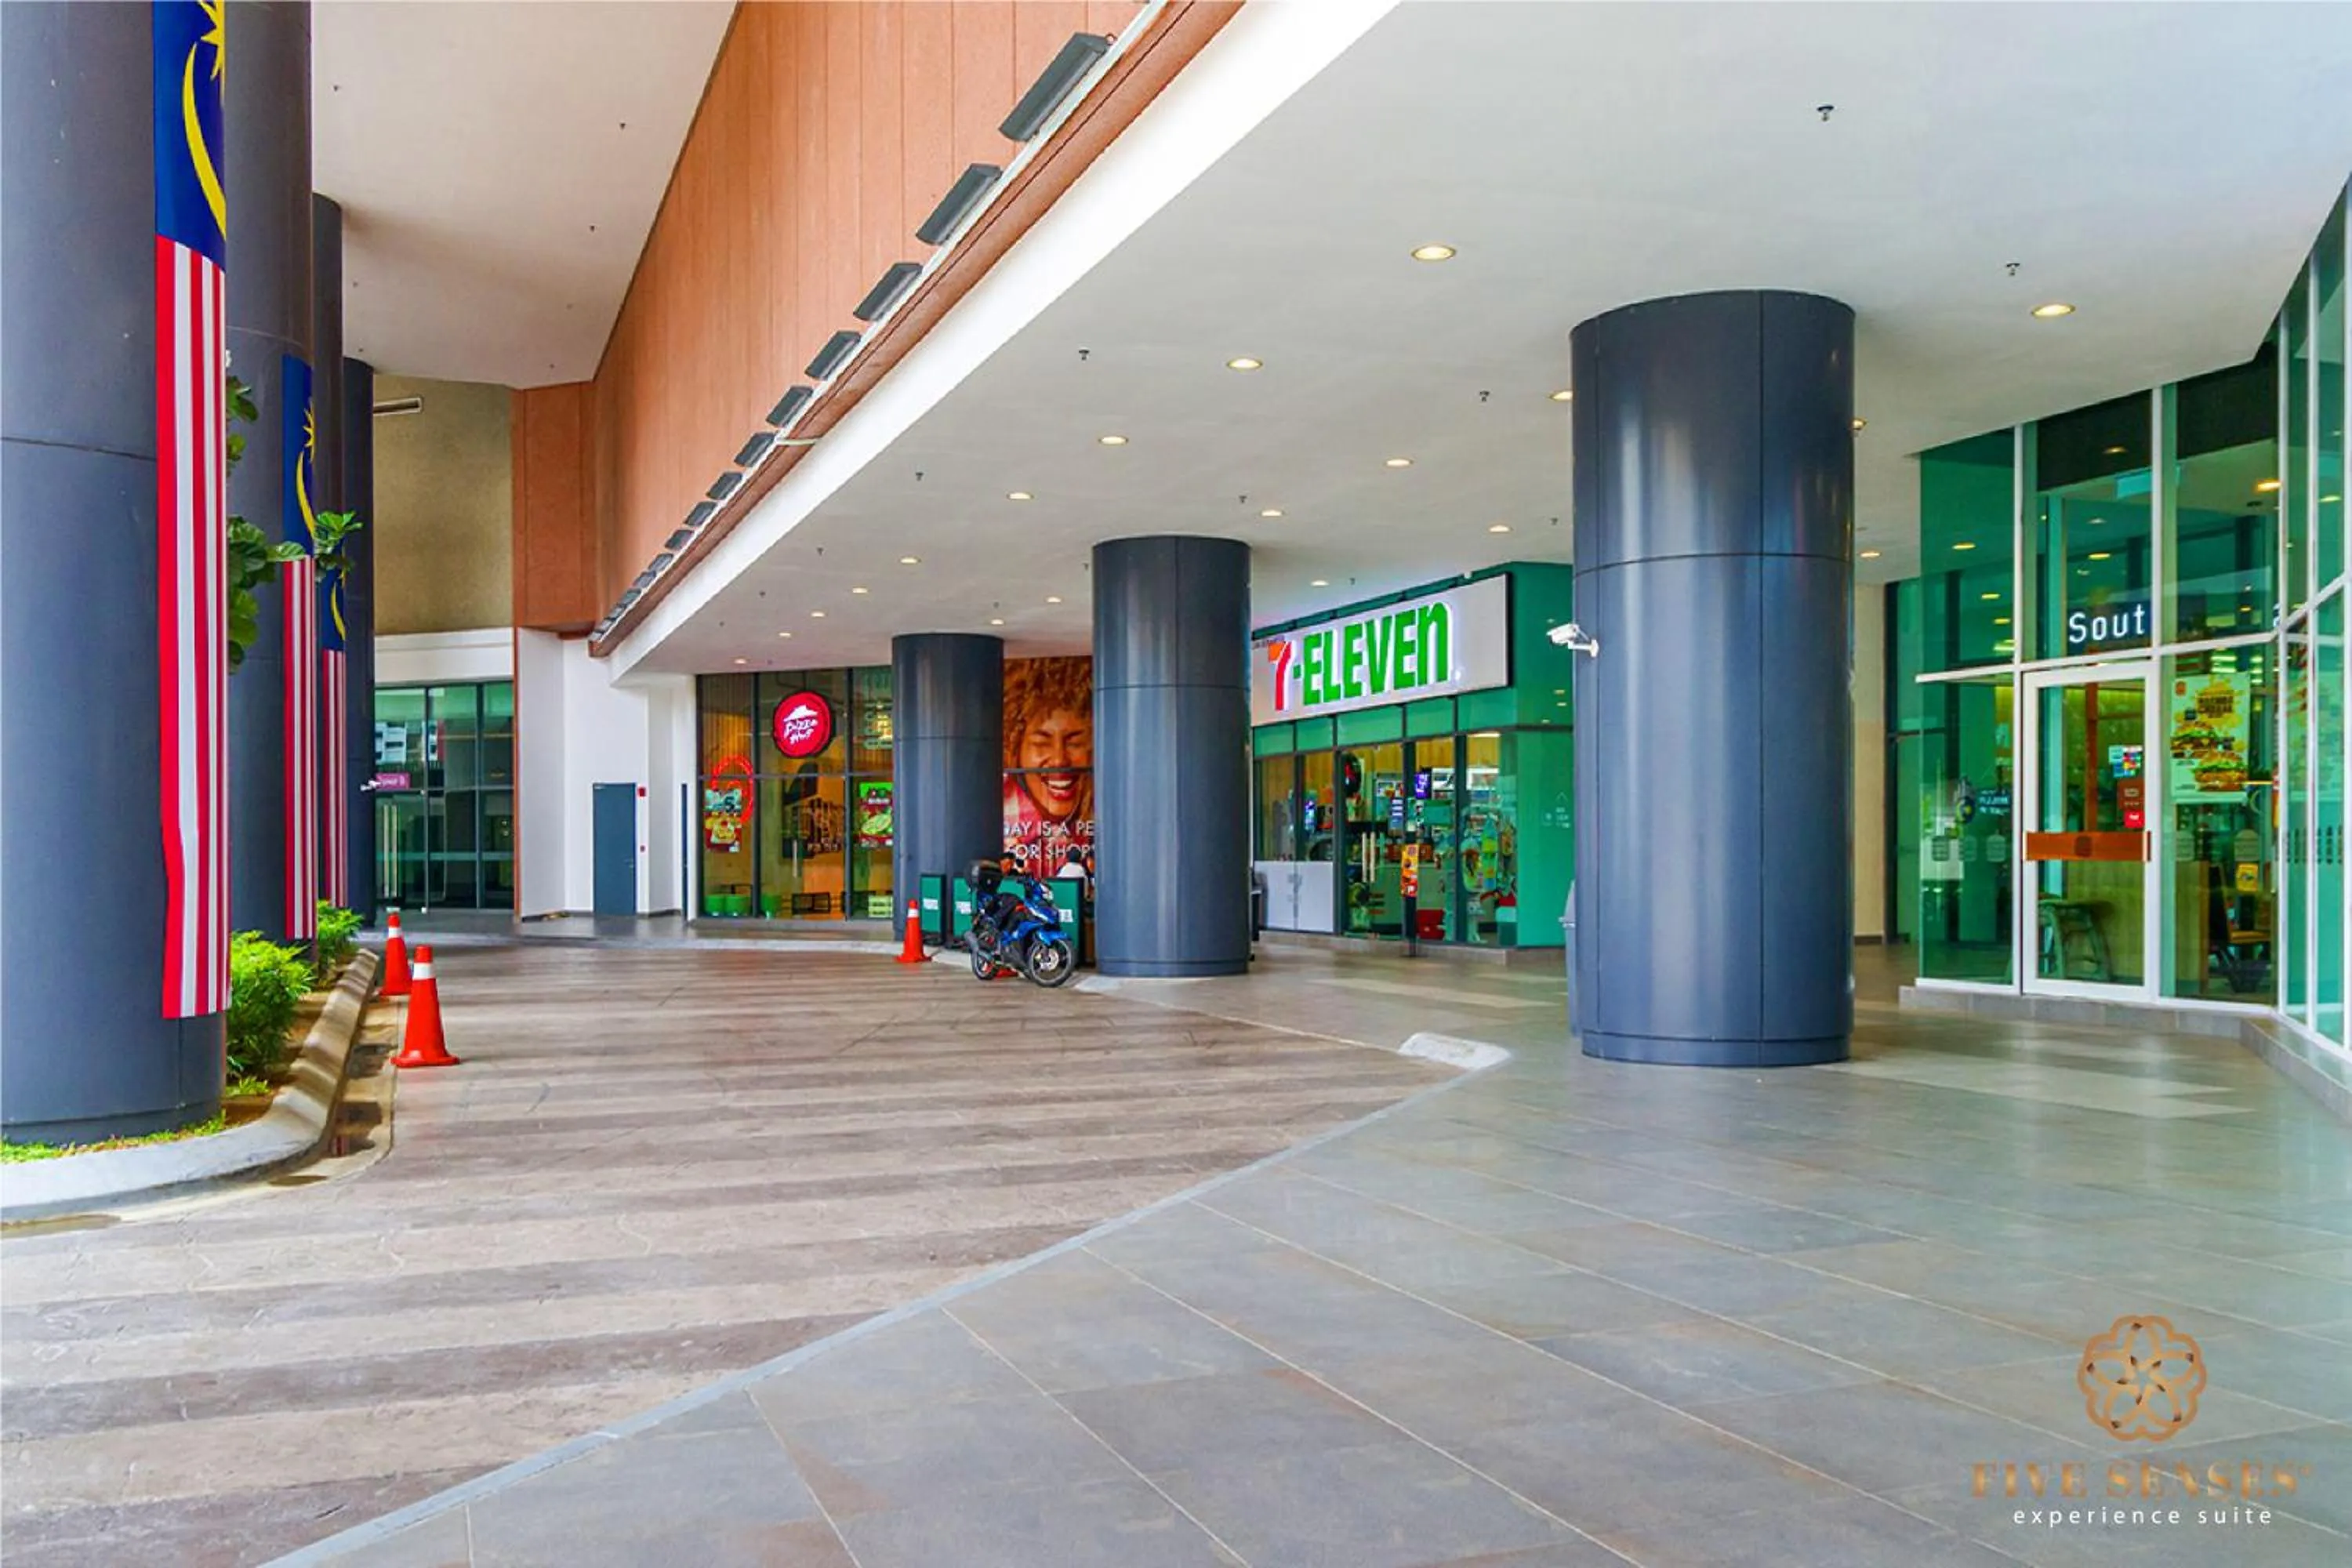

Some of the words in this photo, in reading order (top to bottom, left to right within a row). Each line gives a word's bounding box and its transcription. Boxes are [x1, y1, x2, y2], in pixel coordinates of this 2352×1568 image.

[2068, 603, 2147, 644] Sout
[1004, 821, 1033, 836] DAY
[1037, 821, 1051, 837] IS
[1059, 822, 1071, 836] A
[1077, 820, 1094, 836] PE
[1047, 843, 1095, 860] SHOP
